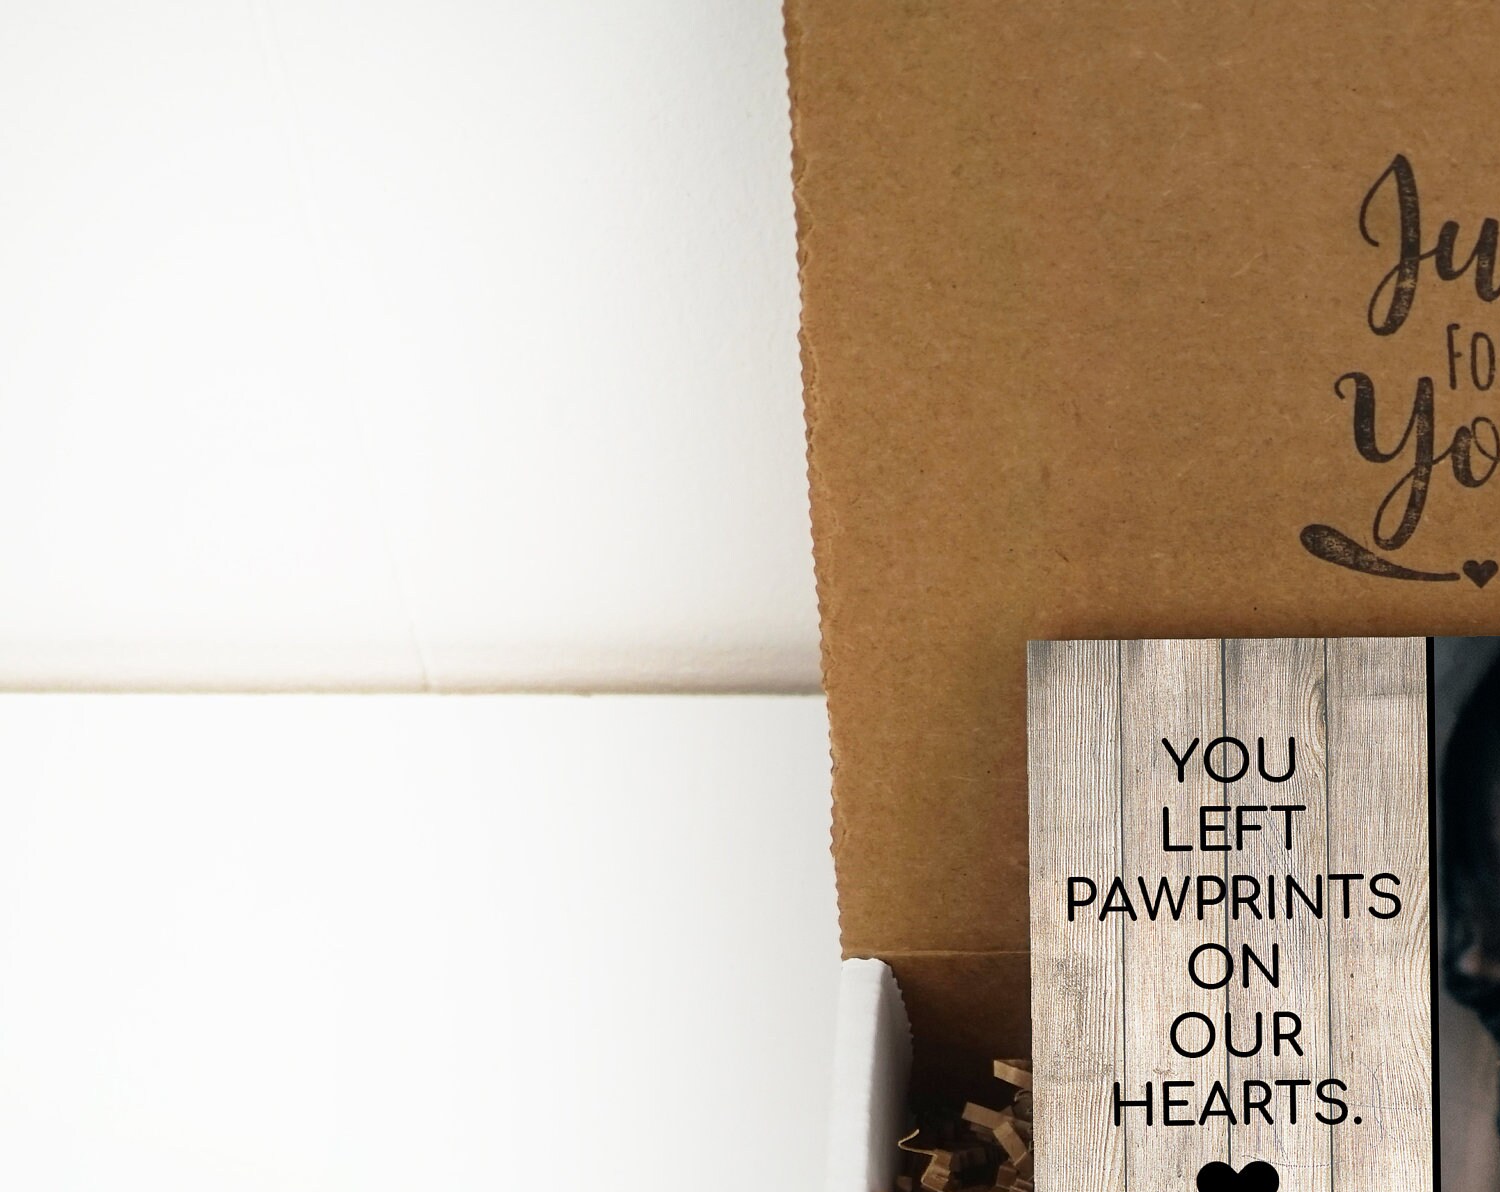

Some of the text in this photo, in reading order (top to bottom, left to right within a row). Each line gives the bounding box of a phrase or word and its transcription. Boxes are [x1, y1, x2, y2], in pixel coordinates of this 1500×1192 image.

[1161, 736, 1296, 784] YOU
[1162, 804, 1307, 852] LEFT
[1067, 872, 1403, 922] PAWPRINTS
[1188, 942, 1279, 990] ON
[1170, 1011, 1304, 1059] OUR
[1113, 1078, 1362, 1127] HEARTS.
